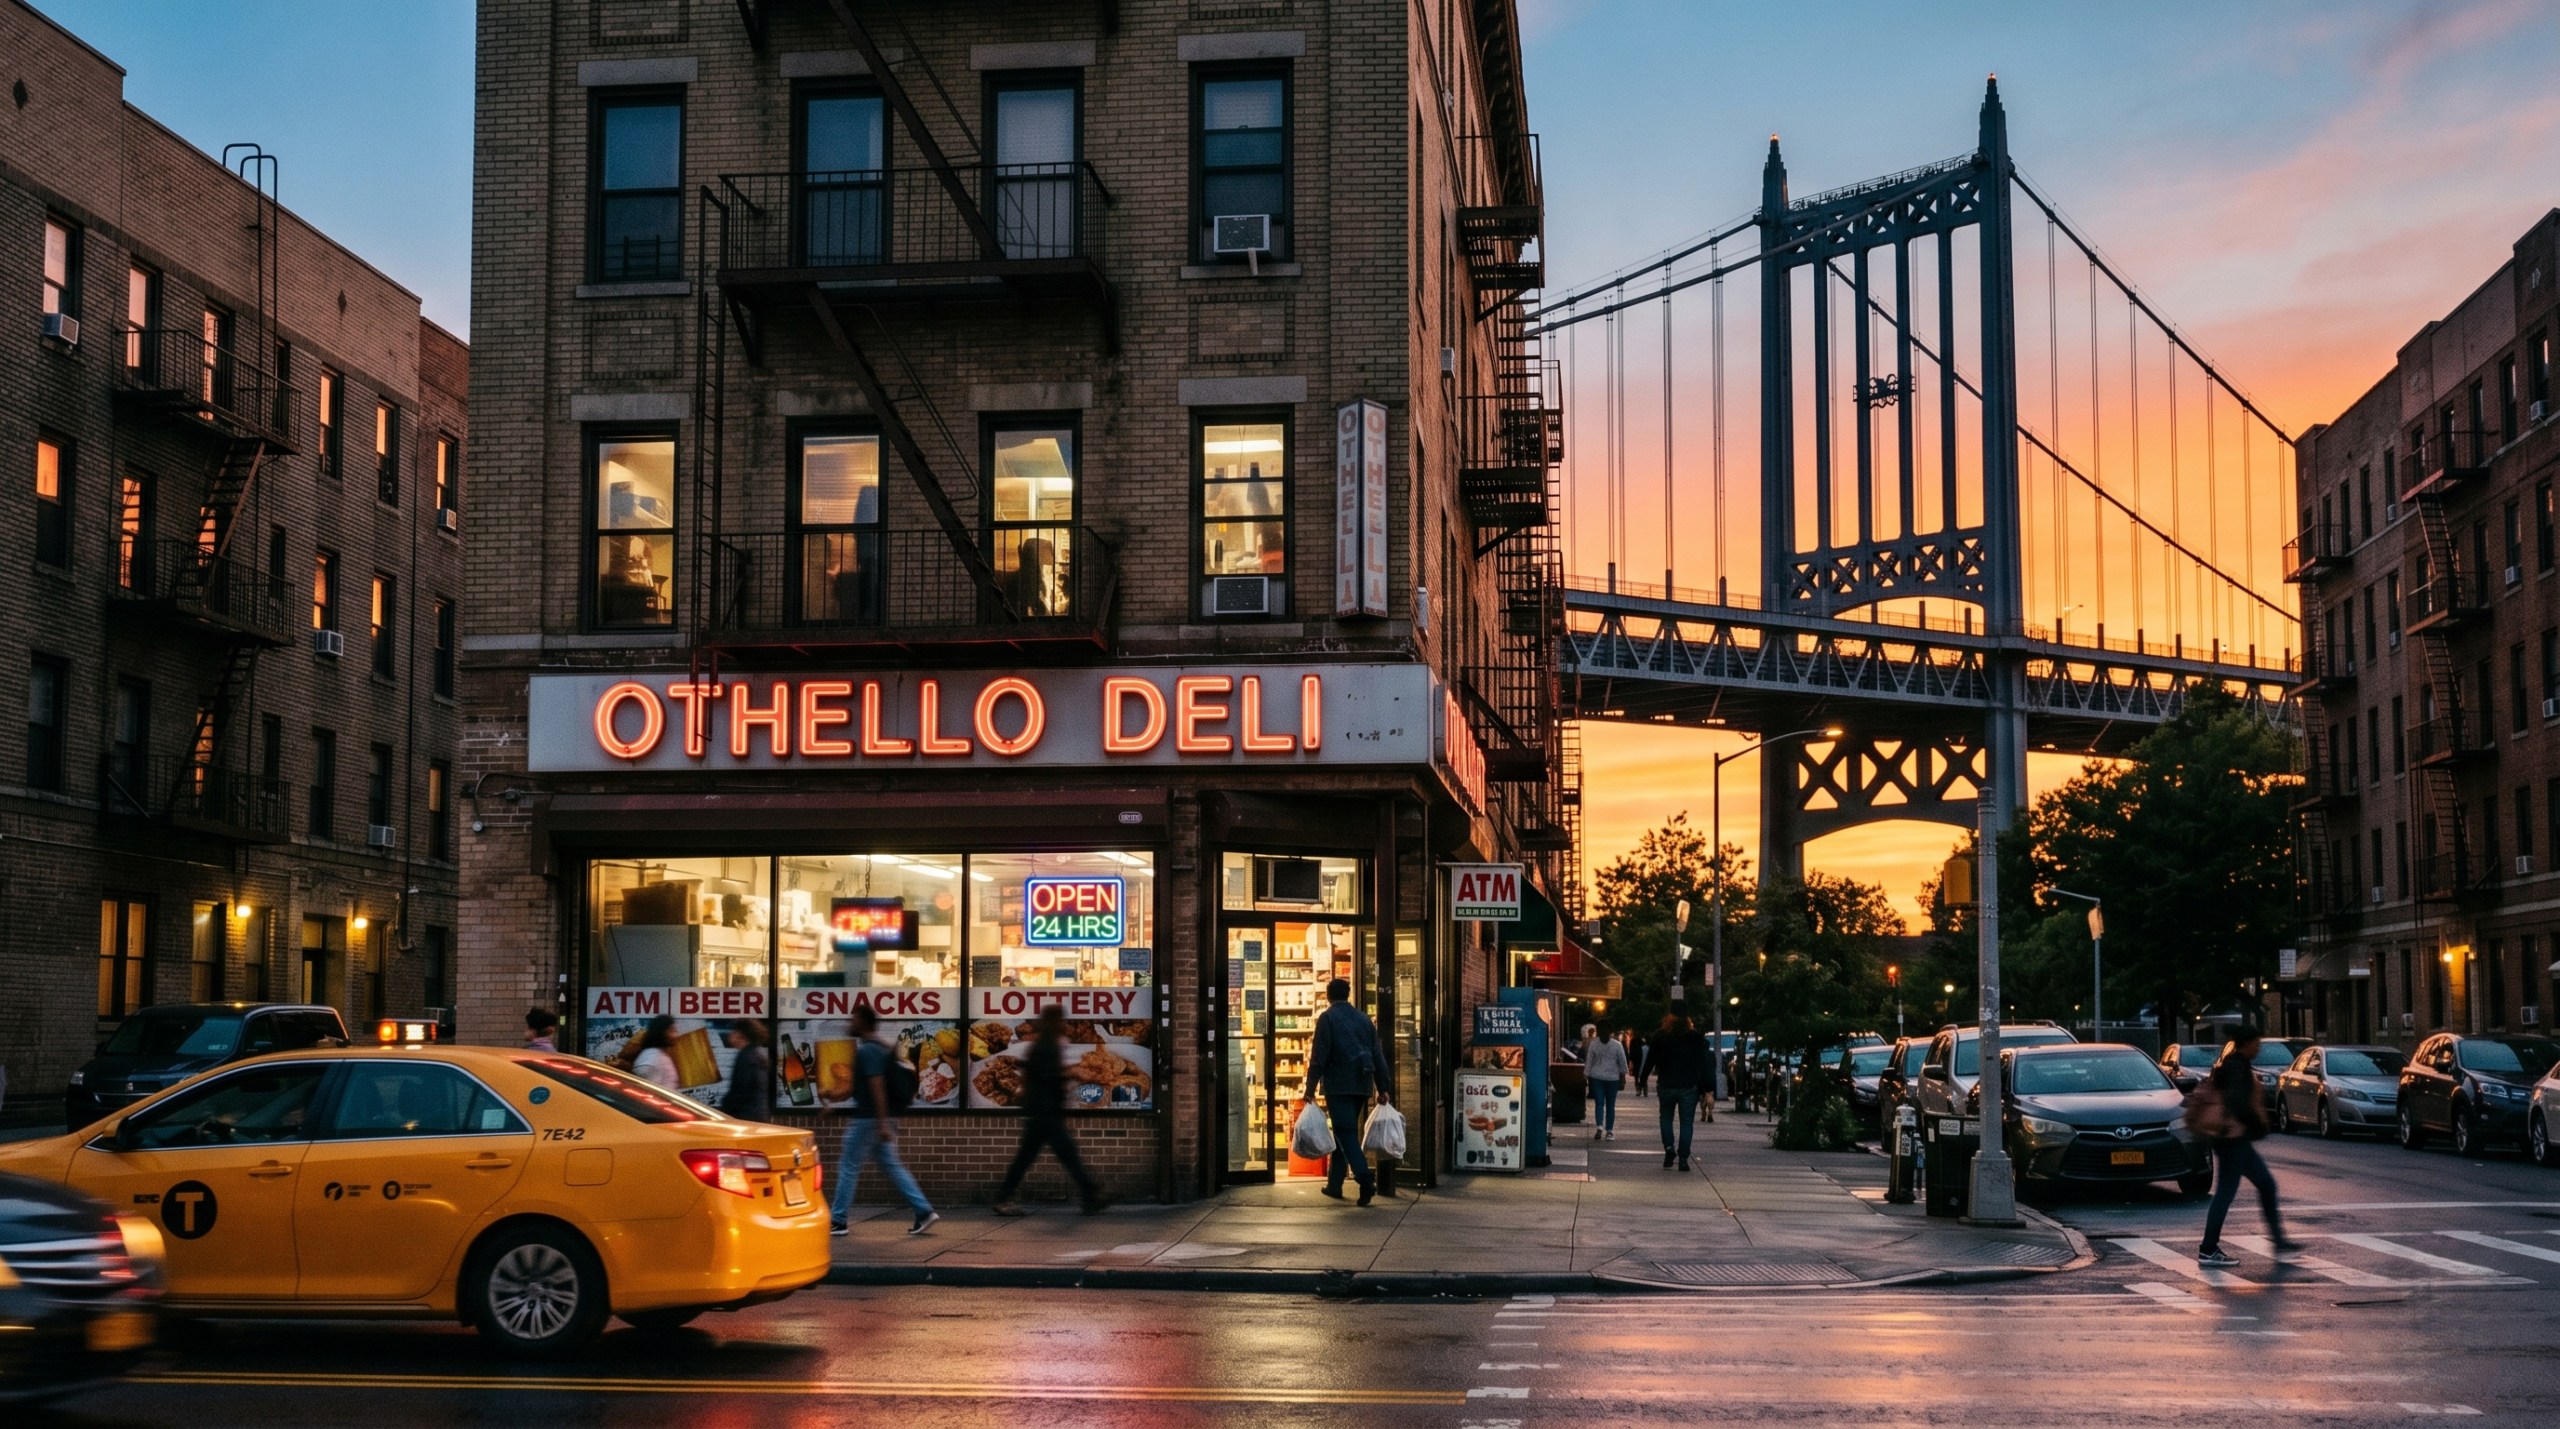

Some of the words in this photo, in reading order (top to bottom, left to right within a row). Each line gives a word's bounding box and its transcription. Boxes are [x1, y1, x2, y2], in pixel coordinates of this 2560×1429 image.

[594, 678, 1045, 758] OTHELLO
[1103, 674, 1321, 752] DELI
[1032, 884, 1116, 912] OPEN
[1457, 873, 1517, 902] ATM
[1032, 915, 1061, 938] 24
[1067, 915, 1117, 938] HRS
[594, 991, 660, 1015] ATM
[679, 991, 764, 1015] BEER
[805, 991, 941, 1015] SNACKS
[984, 991, 1137, 1015] LOTTERY
[543, 1128, 586, 1141] 7E42
[175, 1192, 204, 1232] T
